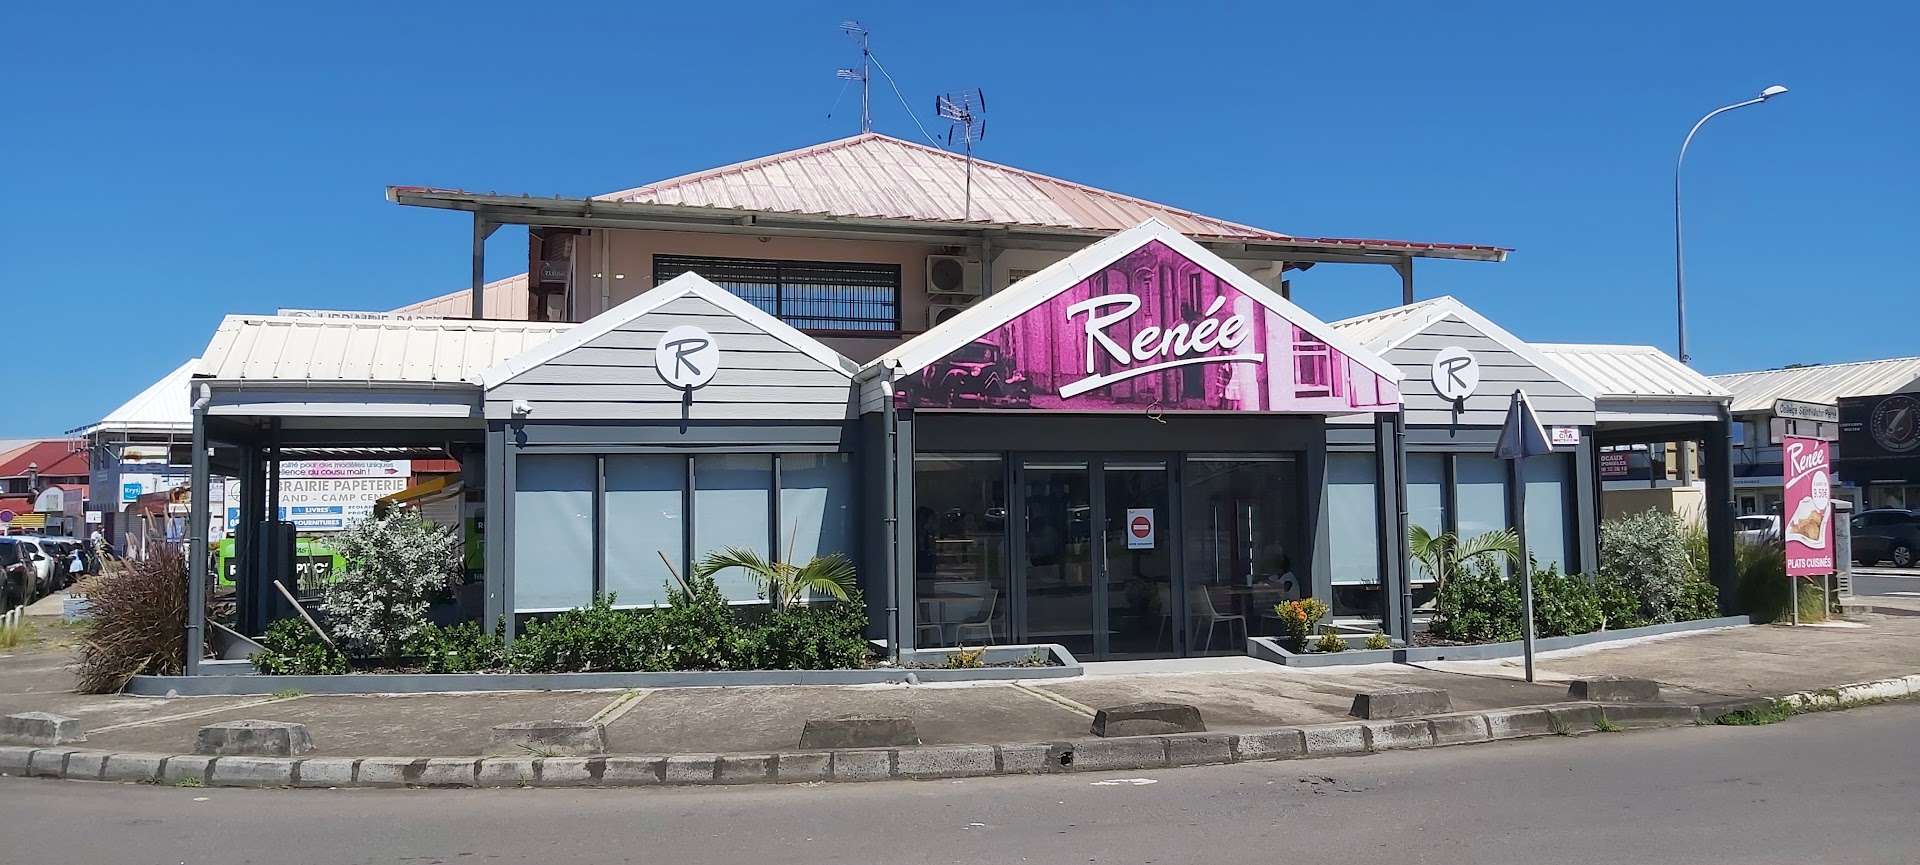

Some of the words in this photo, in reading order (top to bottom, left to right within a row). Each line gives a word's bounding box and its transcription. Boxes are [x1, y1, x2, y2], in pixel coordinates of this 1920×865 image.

[1067, 294, 1249, 374] Renée
[664, 338, 709, 379] R
[1439, 356, 1472, 393] R
[1786, 441, 1825, 477] Renée
[334, 479, 403, 491] PAPETERIE
[321, 493, 356, 503] CAMP
[305, 506, 330, 514] LIVRES
[294, 518, 340, 527] FOURNITURES
[1787, 558, 1806, 569] PLATS
[1806, 554, 1832, 568] CUISINÉS
